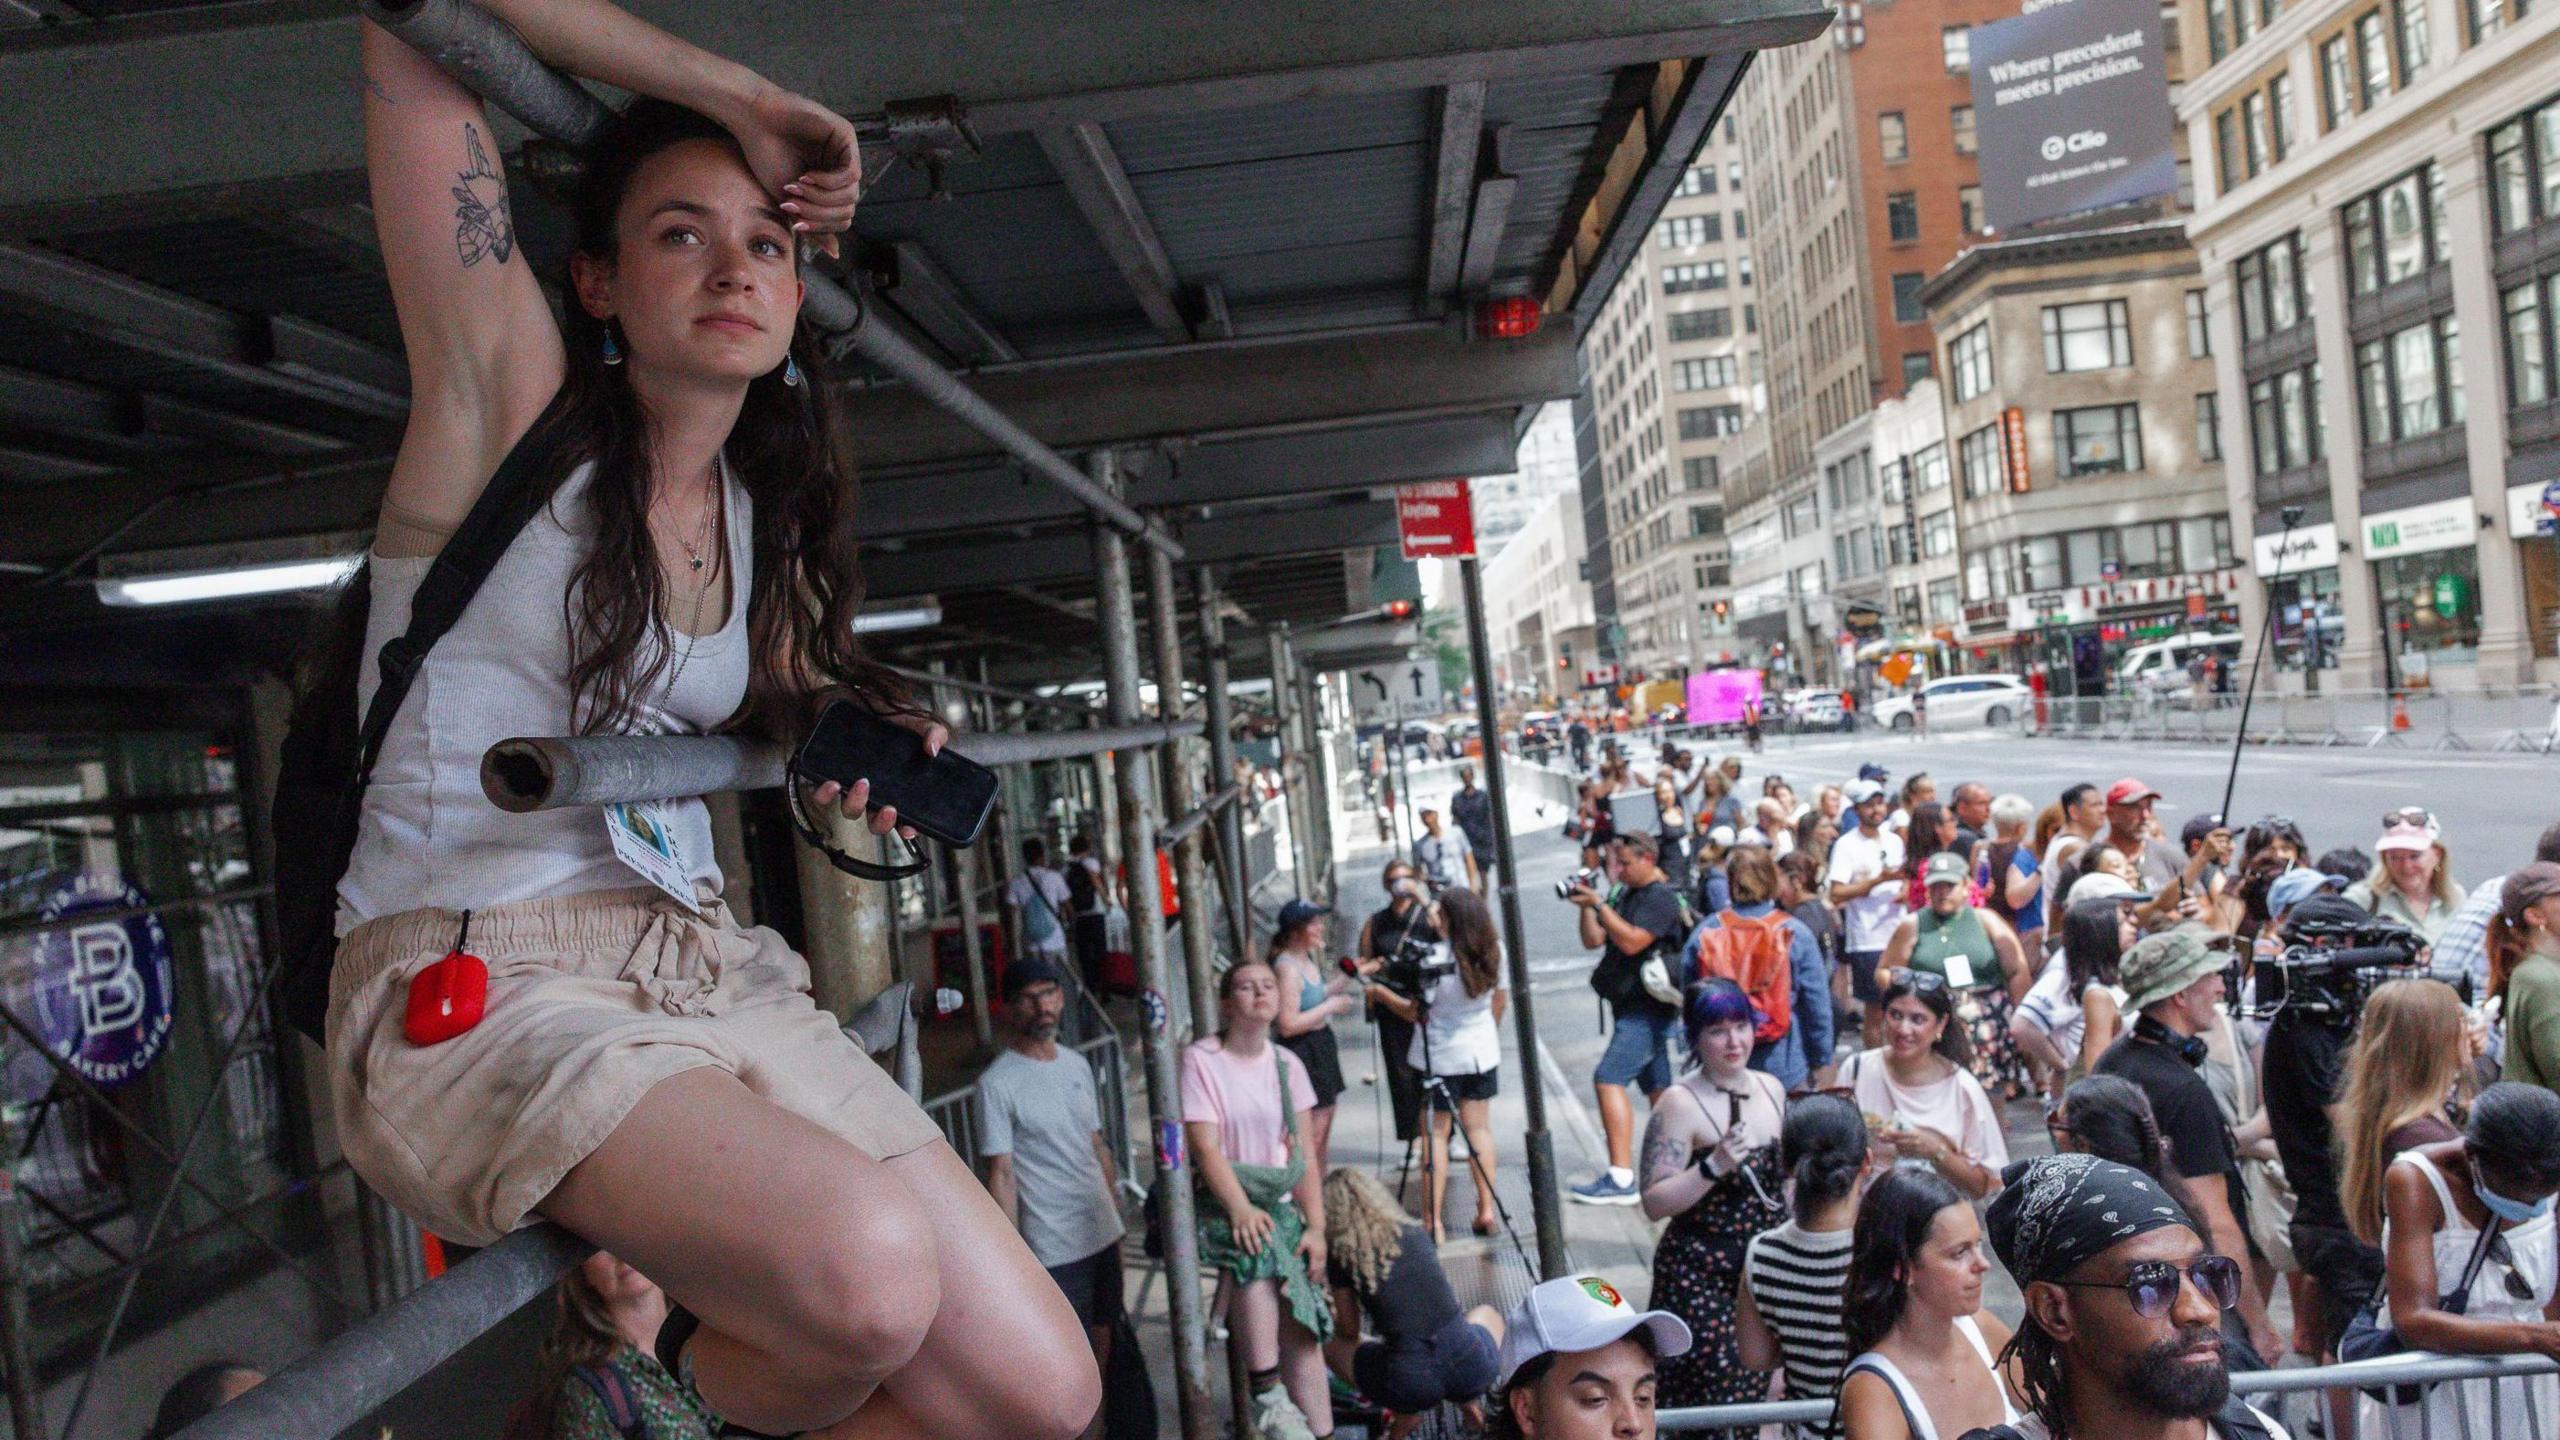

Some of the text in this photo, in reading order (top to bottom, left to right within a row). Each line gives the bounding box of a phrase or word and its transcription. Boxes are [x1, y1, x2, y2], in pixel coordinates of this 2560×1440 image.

[1988, 29, 2145, 85] Where precedent
[1995, 55, 2145, 106] meets precision.
[2066, 129, 2108, 153] Clio
[1402, 501, 1440, 520] Anytime
[58, 1039, 129, 1081] BAKERY
